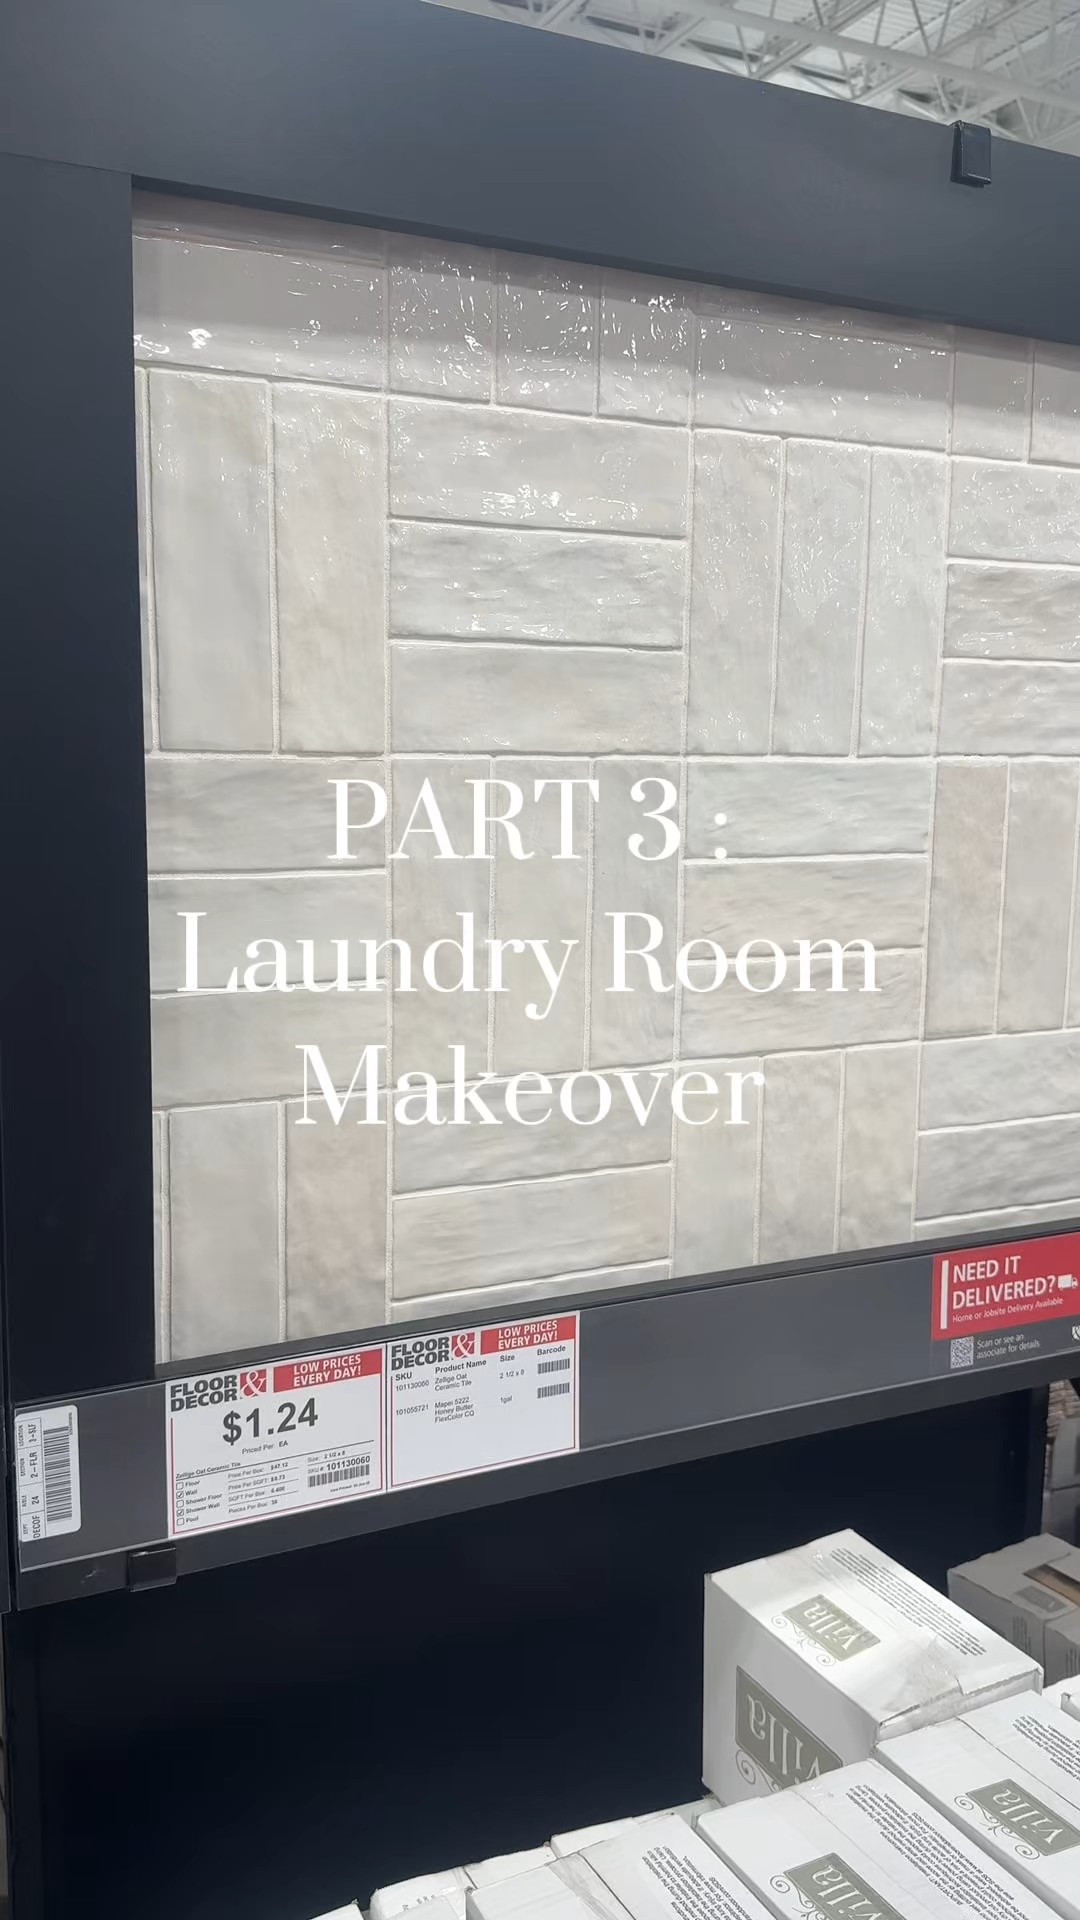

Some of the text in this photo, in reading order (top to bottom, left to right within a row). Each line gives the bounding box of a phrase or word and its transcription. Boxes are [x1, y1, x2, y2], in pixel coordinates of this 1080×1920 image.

[953, 1256, 1021, 1283] NEED IT
[953, 1275, 1056, 1310] DELIVERED?
[952, 1312, 972, 1323] Home
[974, 1311, 982, 1319] or
[1007, 1303, 1034, 1314] Delivery
[1035, 1297, 1063, 1308] Available
[499, 1320, 558, 1339] LOW PRICES
[391, 1333, 474, 1358] FLOOR &
[498, 1331, 558, 1350] EVERY DAY!
[977, 1338, 993, 1349] Scan
[995, 1337, 1002, 1345] or
[1003, 1335, 1014, 1343] see
[500, 1354, 515, 1362] Size
[537, 1345, 566, 1356] Barcode
[977, 1340, 1040, 1359] associate for details
[294, 1354, 361, 1376] LOW PRICES
[391, 1349, 450, 1371] DECOR
[435, 1359, 487, 1374] Product Name
[171, 1370, 266, 1398] FLOOR &
[294, 1365, 361, 1387] EVERY DAY!
[395, 1371, 413, 1382] SKU
[435, 1376, 455, 1385] Zellige
[435, 1382, 460, 1392] Ceramic
[171, 1388, 237, 1412] DECOR
[435, 1397, 470, 1409] Mapei 5222
[435, 1404, 474, 1416] Honey Butter
[435, 1413, 463, 1423] FlexColor
[222, 1397, 318, 1446] $1.24
[242, 1446, 262, 1454] Priced
[30, 1452, 38, 1478] 2-FLR
[326, 1456, 371, 1471] 101130060
[185, 1480, 200, 1488] Floor
[32, 1496, 40, 1505] 24
[185, 1497, 207, 1505] Shower
[186, 1506, 207, 1514] Shower
[804, 1601, 857, 1650] villa
[992, 1788, 1064, 1845] villa
